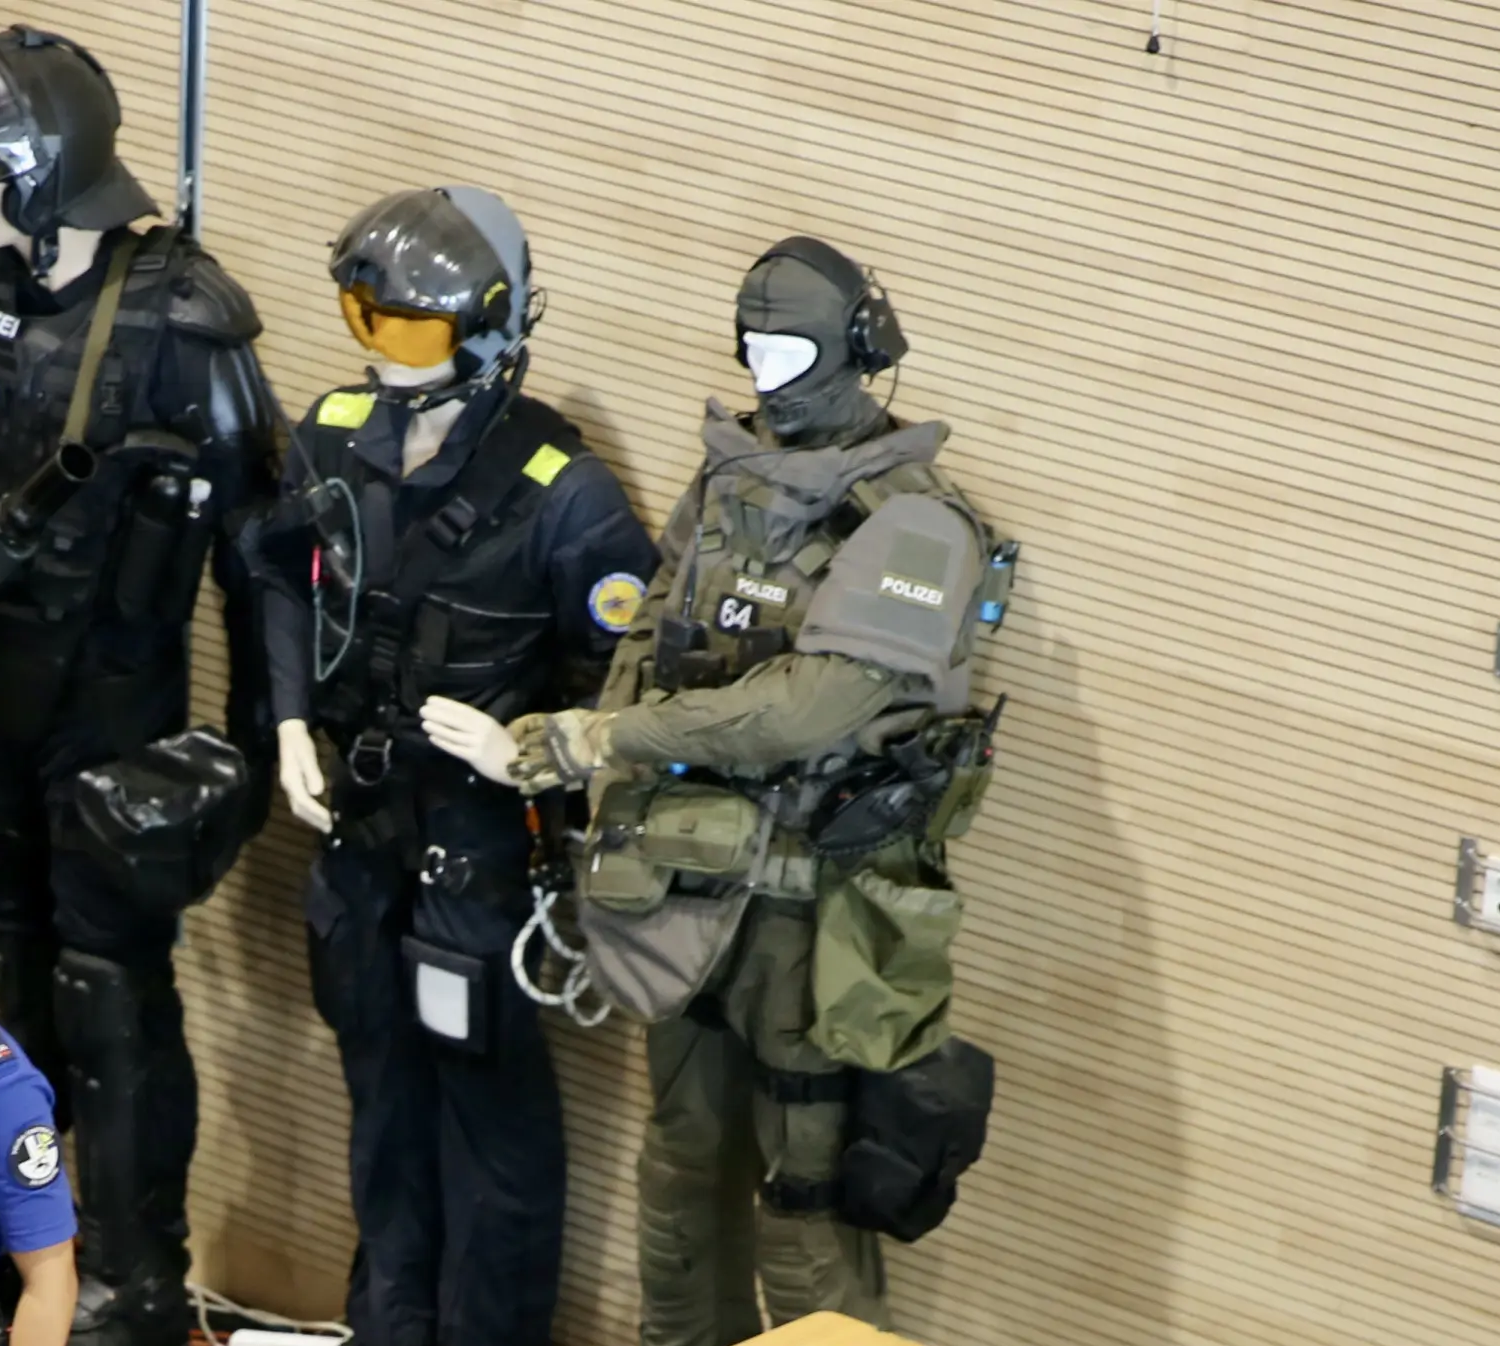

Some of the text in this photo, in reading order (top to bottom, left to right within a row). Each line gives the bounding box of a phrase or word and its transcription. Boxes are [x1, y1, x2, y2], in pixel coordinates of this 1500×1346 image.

[736, 577, 789, 603] POLIZEI
[880, 576, 944, 606] POLIZEI
[719, 597, 753, 630] 64
